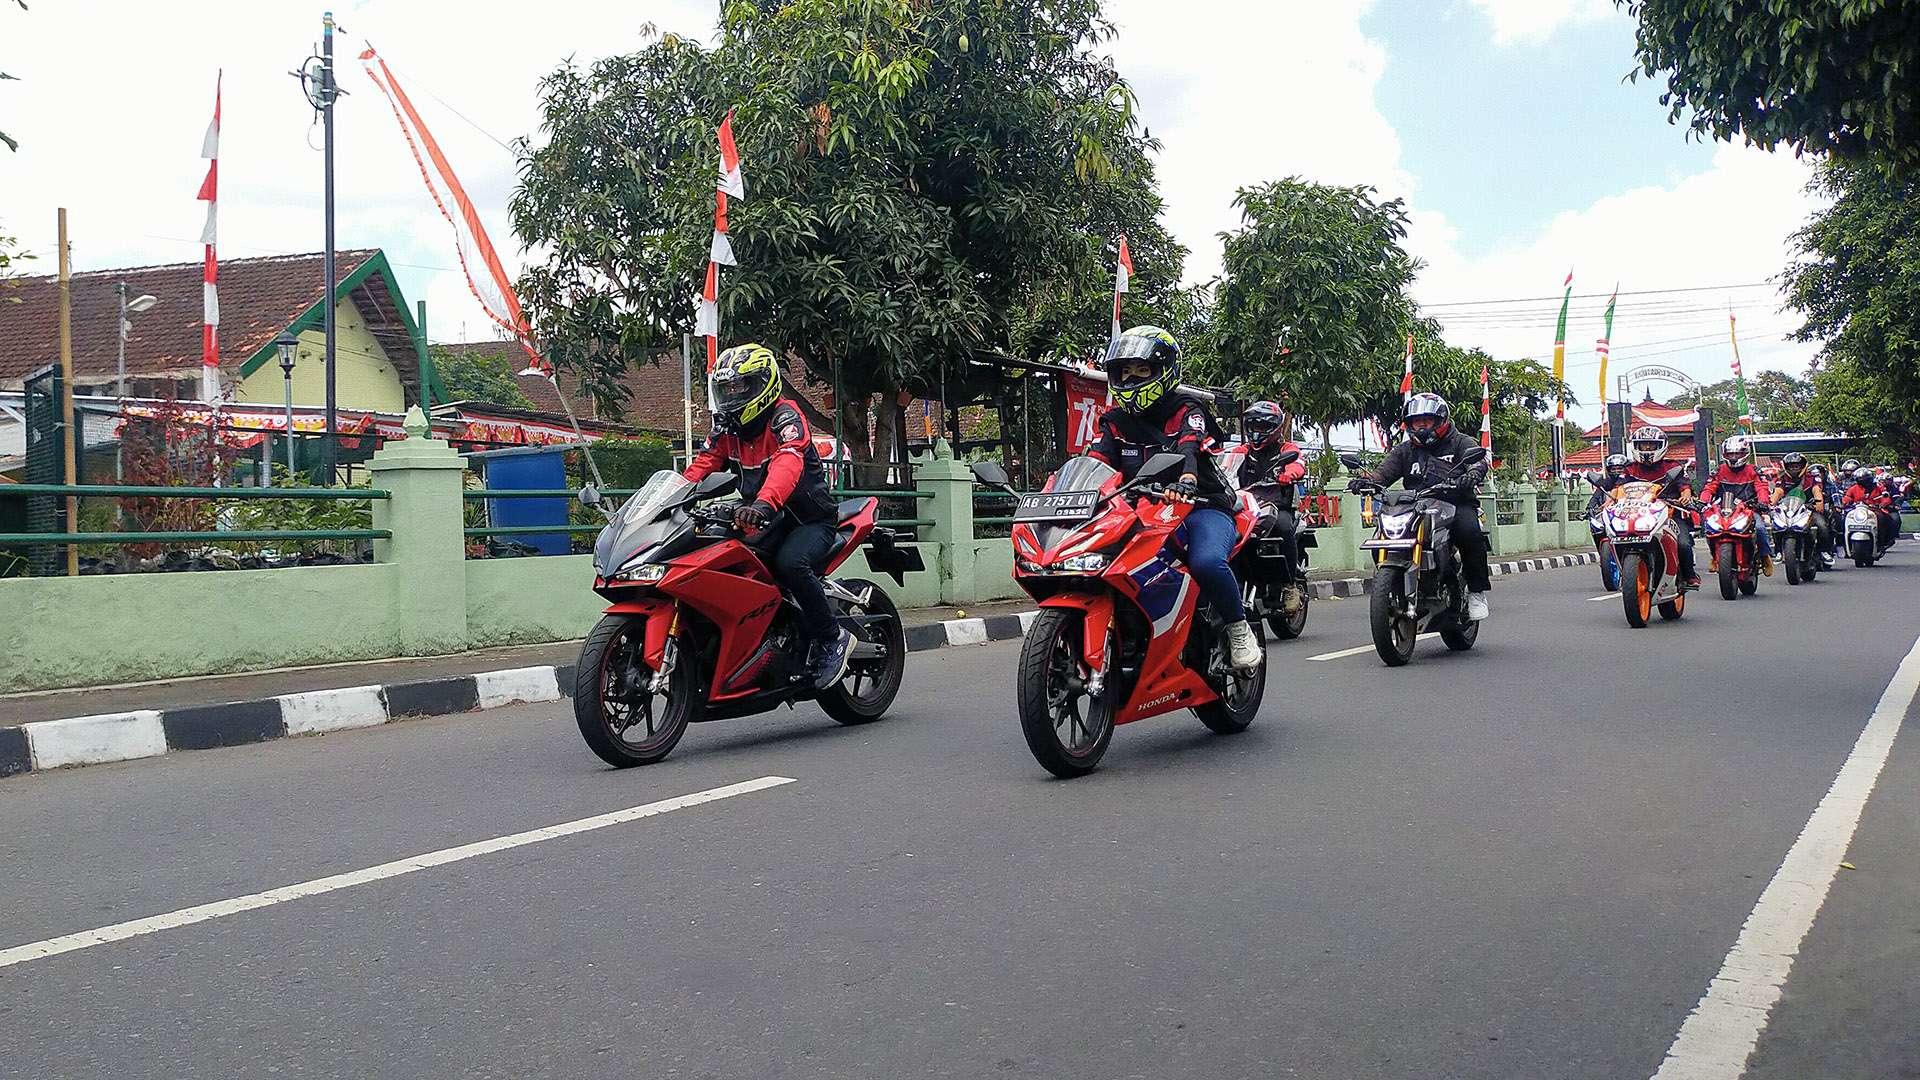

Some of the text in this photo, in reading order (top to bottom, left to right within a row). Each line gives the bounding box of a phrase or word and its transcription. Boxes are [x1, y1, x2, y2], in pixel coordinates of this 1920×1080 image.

[1023, 494, 1094, 508] AB 2757 UV
[1137, 692, 1176, 711] HONDA
